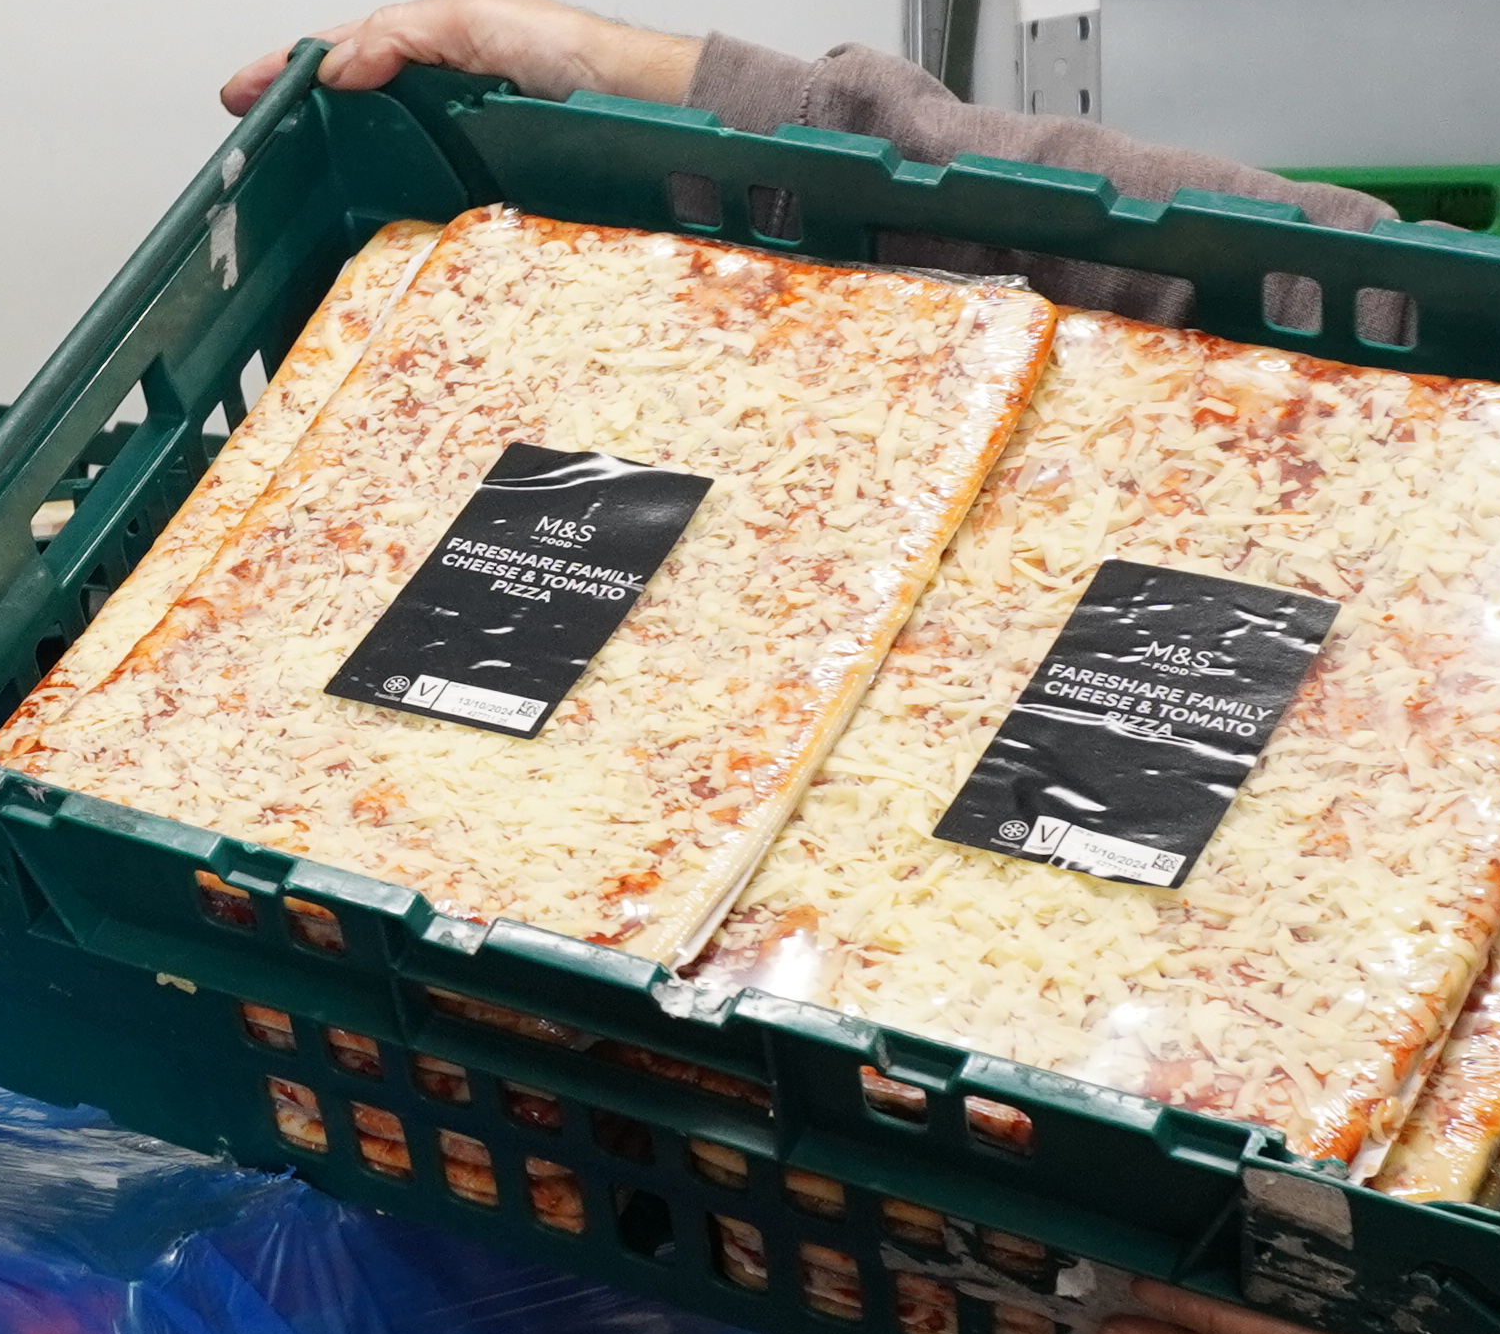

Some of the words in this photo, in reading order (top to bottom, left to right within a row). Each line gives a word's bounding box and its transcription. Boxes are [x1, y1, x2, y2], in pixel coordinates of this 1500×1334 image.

[534, 515, 597, 542] M&S
[540, 536, 572, 549] FOOD
[446, 537, 567, 572] FARESHARE
[566, 562, 643, 585] FAMILY
[441, 553, 521, 580] CHEESE
[521, 570, 536, 583] &
[540, 573, 626, 601] TOMATO
[490, 579, 552, 603] PIZZA
[1145, 640, 1214, 669] M&S
[1152, 662, 1190, 676] FOOD
[420, 682, 438, 697] V
[1047, 663, 1185, 704] FARESHARE
[1186, 692, 1274, 722] FAMILY
[458, 697, 515, 716] 13/10/2024
[1043, 681, 1135, 711] CHEESE
[1135, 699, 1153, 715] &
[1158, 703, 1257, 737] TOMATO
[1103, 710, 1173, 738] PIZZA
[1041, 824, 1059, 844] V
[1083, 842, 1149, 870] 13/10/2024
